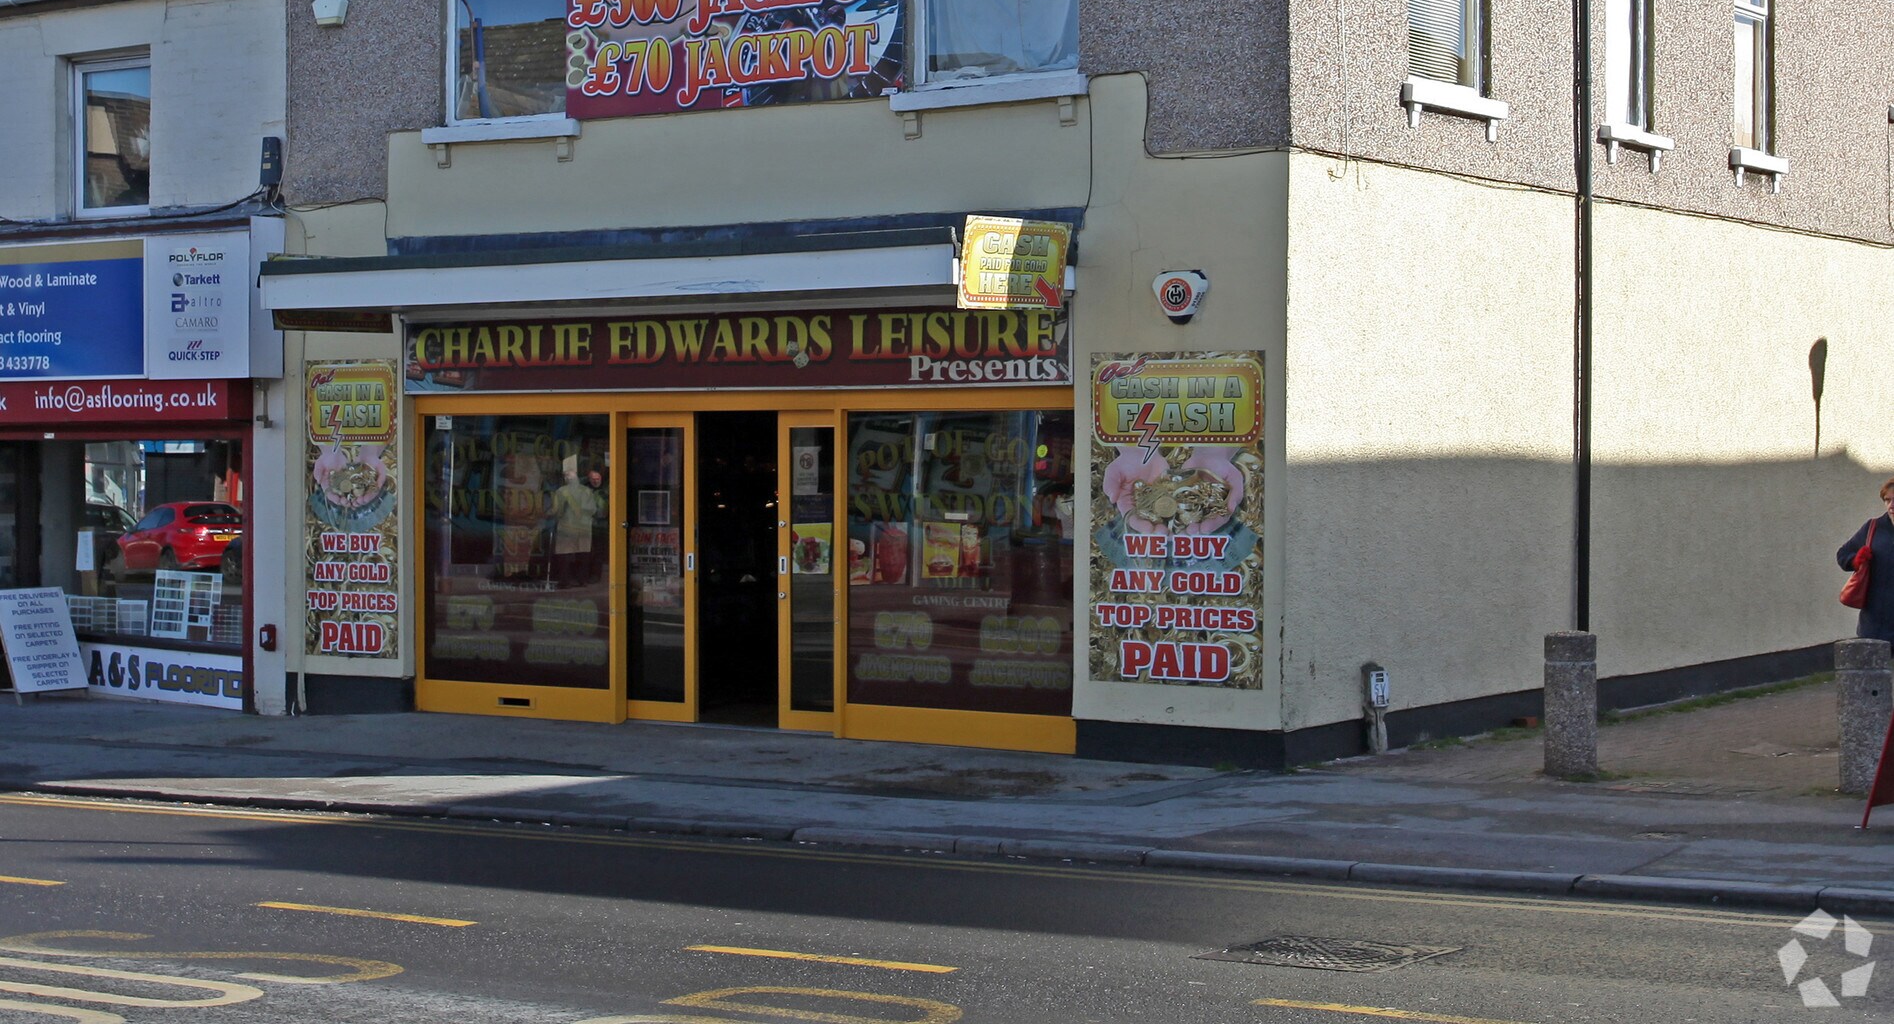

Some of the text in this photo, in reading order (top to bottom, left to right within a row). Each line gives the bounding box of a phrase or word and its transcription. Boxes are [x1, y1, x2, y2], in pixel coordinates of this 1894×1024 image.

[582, 22, 879, 107] £70 JACKPOT
[983, 232, 1050, 256] CASH
[169, 253, 223, 262] POLYFLOR
[980, 257, 1047, 273] PAID FOR GOLD
[0, 272, 97, 288] Wood & Laminate
[184, 274, 220, 285] Tarkett
[978, 272, 1033, 295] HERE
[7, 303, 15, 316] &
[19, 302, 45, 317] Vinyl
[191, 296, 221, 307] altro
[175, 317, 218, 328] CAMARO
[17, 329, 61, 346] flooring
[415, 309, 1057, 369] CHARLIE EDWARDS LEISURE
[908, 353, 1060, 381] Presents
[1100, 356, 1148, 384] Get
[35, 382, 217, 412] info@asflooring.co.uk
[316, 383, 384, 402] CASH IN A
[1111, 376, 1243, 399] CASH IN A
[322, 534, 380, 553] WE BUY
[1124, 534, 1229, 559] WE BUY
[314, 563, 389, 583] ANY GOLD
[1110, 569, 1242, 596] ANY GOLD
[12, 608, 54, 616] PURCHASES
[308, 591, 397, 613] TOP PRICES
[912, 595, 1012, 609] GAMING CENTRE
[1097, 603, 1257, 632] TOP PRICES
[27, 630, 63, 638] SELECTED
[321, 622, 383, 654] PAID
[1121, 640, 1230, 681] PAID
